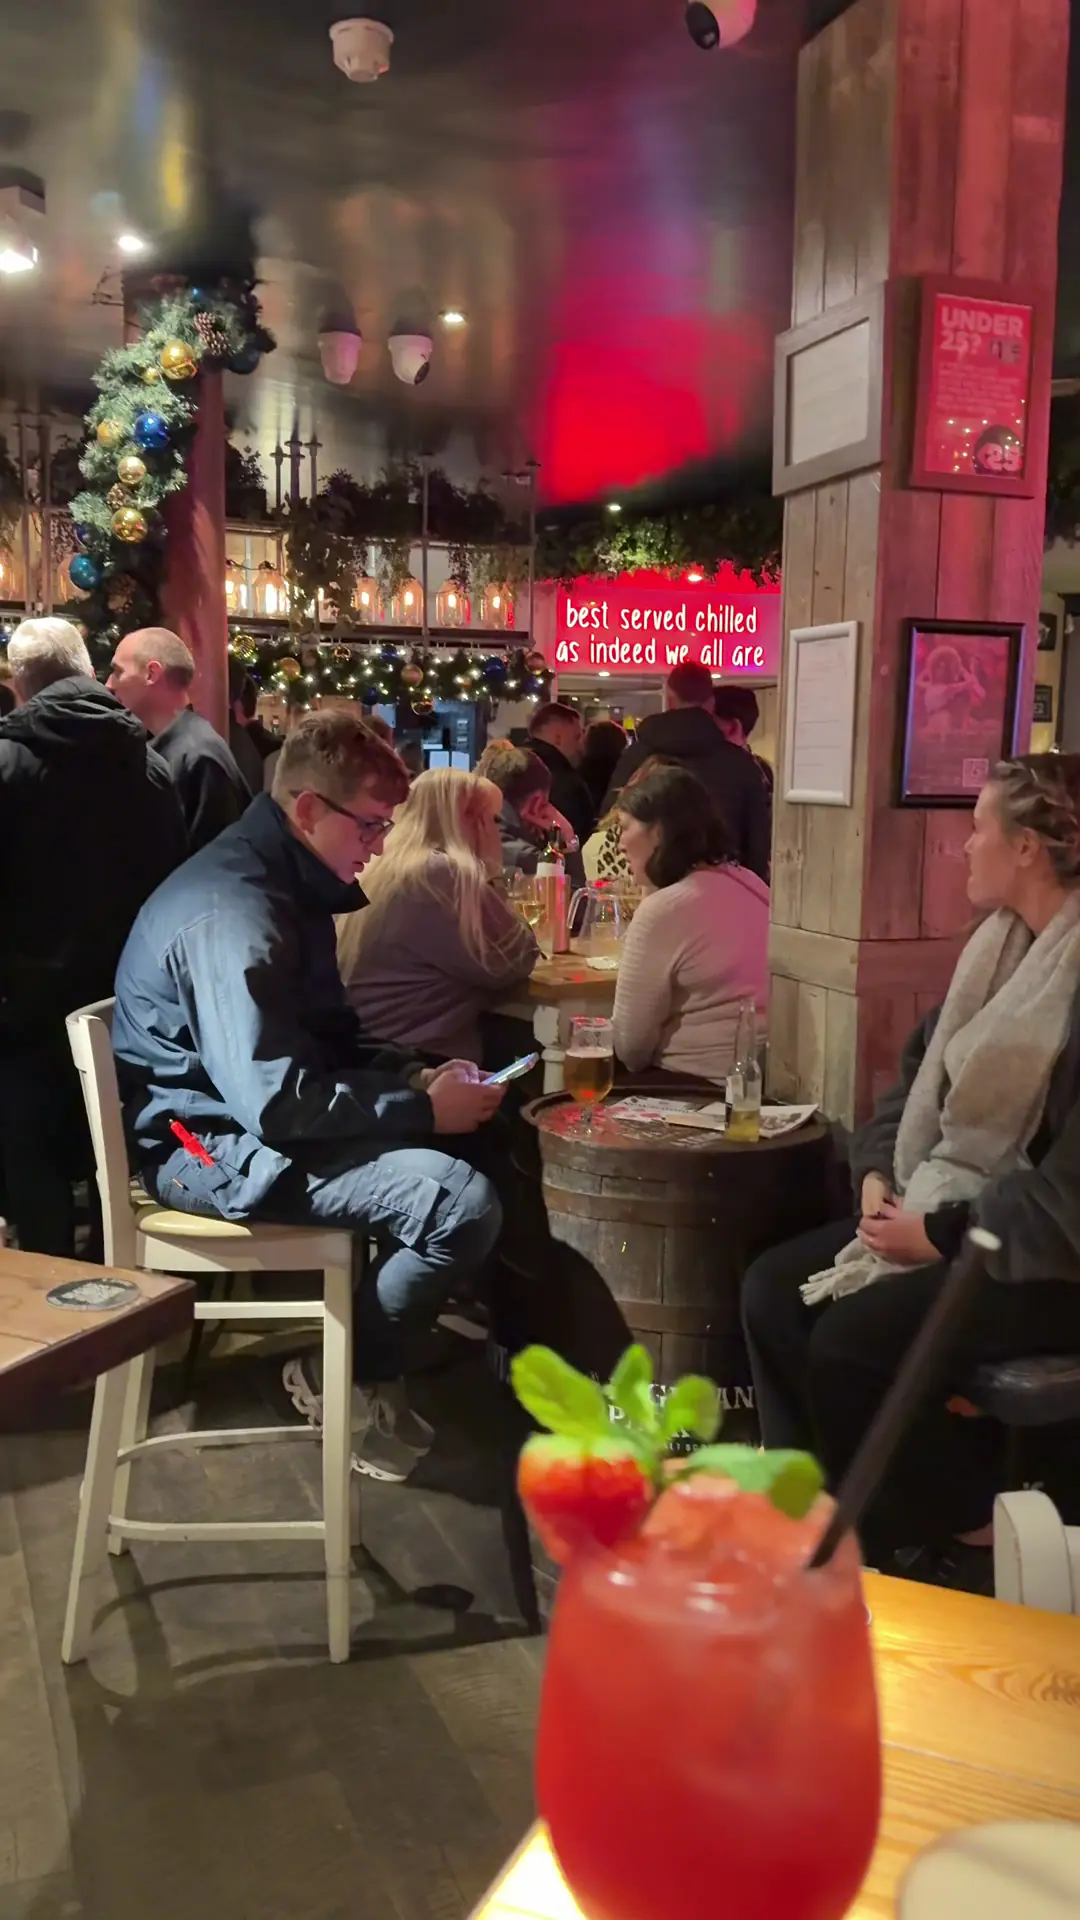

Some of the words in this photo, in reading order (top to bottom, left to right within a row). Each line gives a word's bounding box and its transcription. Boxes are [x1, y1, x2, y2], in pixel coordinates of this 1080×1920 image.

[941, 305, 1024, 338] UNDER
[940, 329, 982, 355] 25?
[566, 598, 609, 630] best
[620, 603, 686, 631] served
[695, 603, 757, 633] chilled
[556, 639, 580, 663] as
[589, 634, 656, 664] indeed
[665, 643, 689, 666] we
[700, 638, 723, 667] all
[731, 645, 765, 667] are
